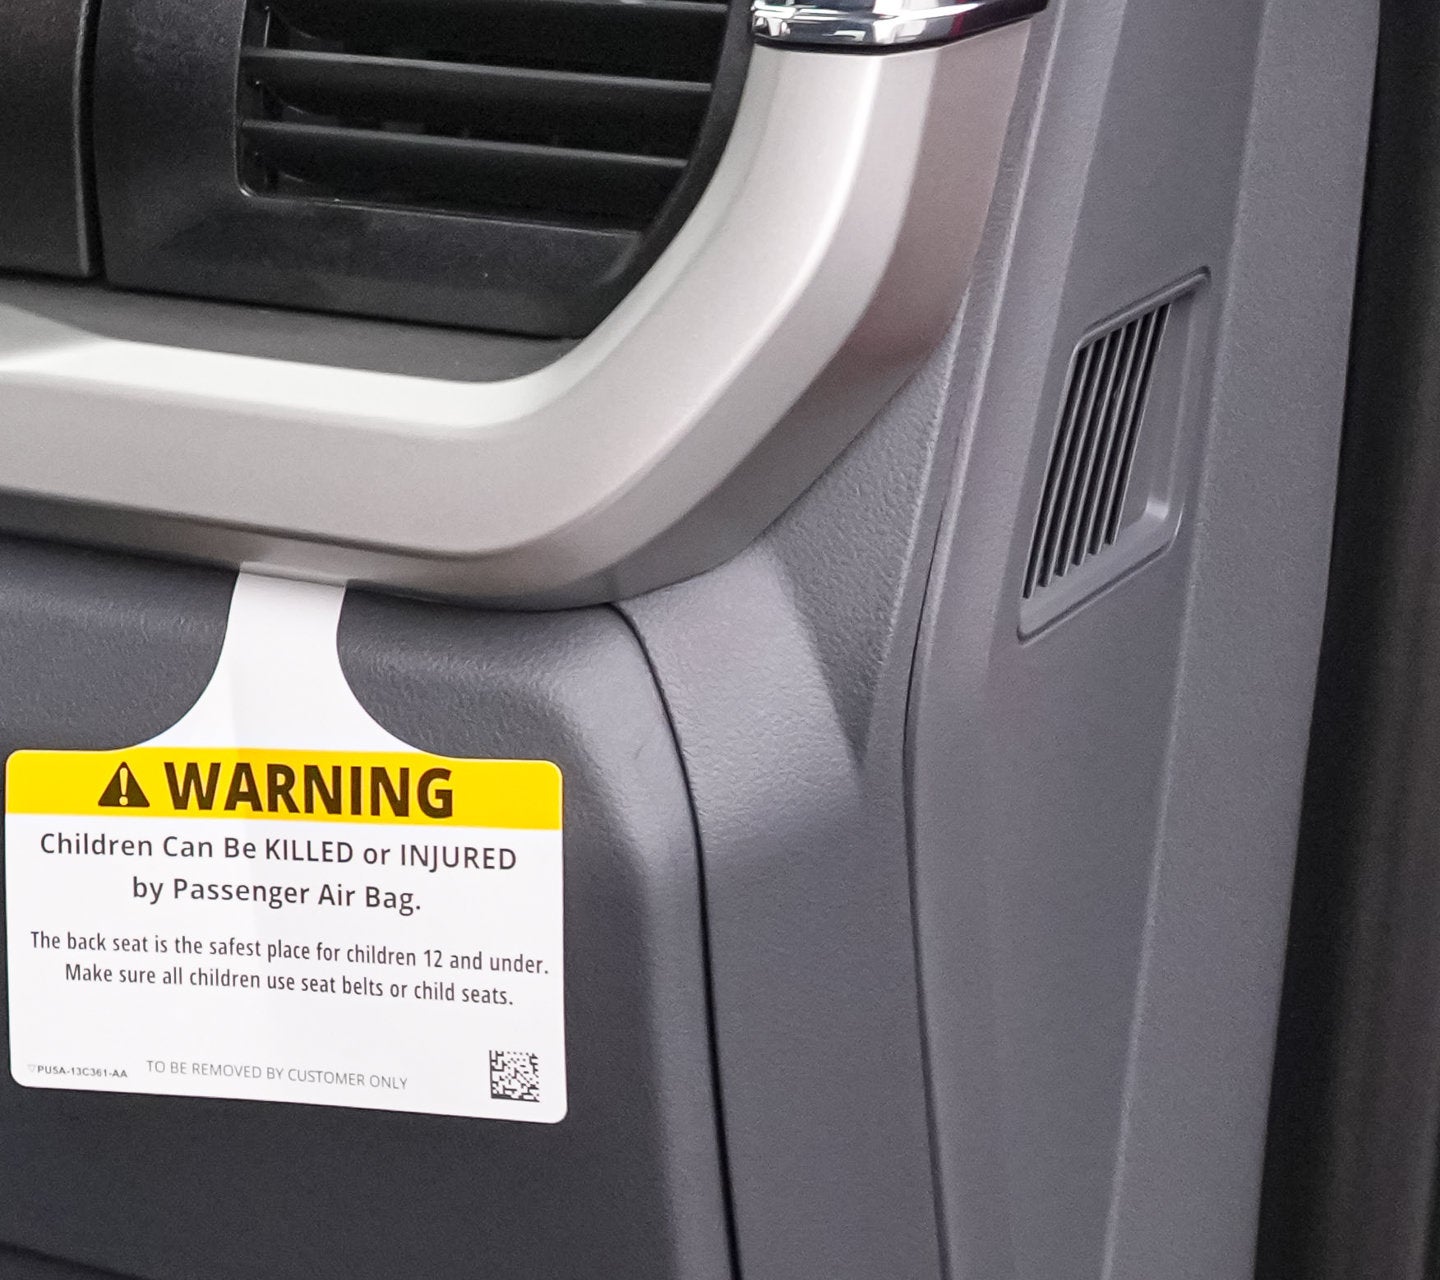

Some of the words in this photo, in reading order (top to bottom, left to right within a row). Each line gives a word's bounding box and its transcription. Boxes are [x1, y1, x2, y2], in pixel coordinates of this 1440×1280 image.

[164, 762, 454, 820] WARNING
[40, 832, 153, 857] Children
[162, 836, 213, 858] Can
[224, 837, 257, 859] Be
[265, 838, 354, 864] KILLED
[362, 847, 392, 866] or
[400, 843, 517, 874] INJURED
[132, 876, 165, 906] by
[173, 877, 311, 910] Passenger
[317, 882, 357, 907] Air
[365, 885, 422, 917] Bag.
[30, 930, 61, 950] The
[66, 930, 107, 952] back
[112, 935, 149, 953] seat
[154, 934, 168, 954] is
[174, 935, 203, 955] the
[209, 936, 262, 958] safest
[267, 938, 311, 964] place
[315, 941, 341, 963] for
[346, 943, 417, 967] children
[423, 949, 444, 969] 12
[449, 950, 483, 971] and
[489, 953, 550, 975] under.
[65, 962, 113, 983] Make
[118, 967, 156, 985] sure
[162, 966, 183, 985] all
[189, 967, 261, 989] children
[266, 974, 296, 991] use
[300, 975, 337, 994] seat
[341, 974, 384, 997] belts
[389, 982, 408, 998] or
[413, 979, 455, 1002] child
[461, 985, 514, 1006] seats.
[145, 1059, 166, 1074] TO
[169, 1060, 188, 1075] BE
[191, 1062, 263, 1079] REMOVED
[266, 1066, 285, 1080] BY
[288, 1068, 366, 1087] CUSTOMER
[369, 1074, 408, 1091] ONLY
